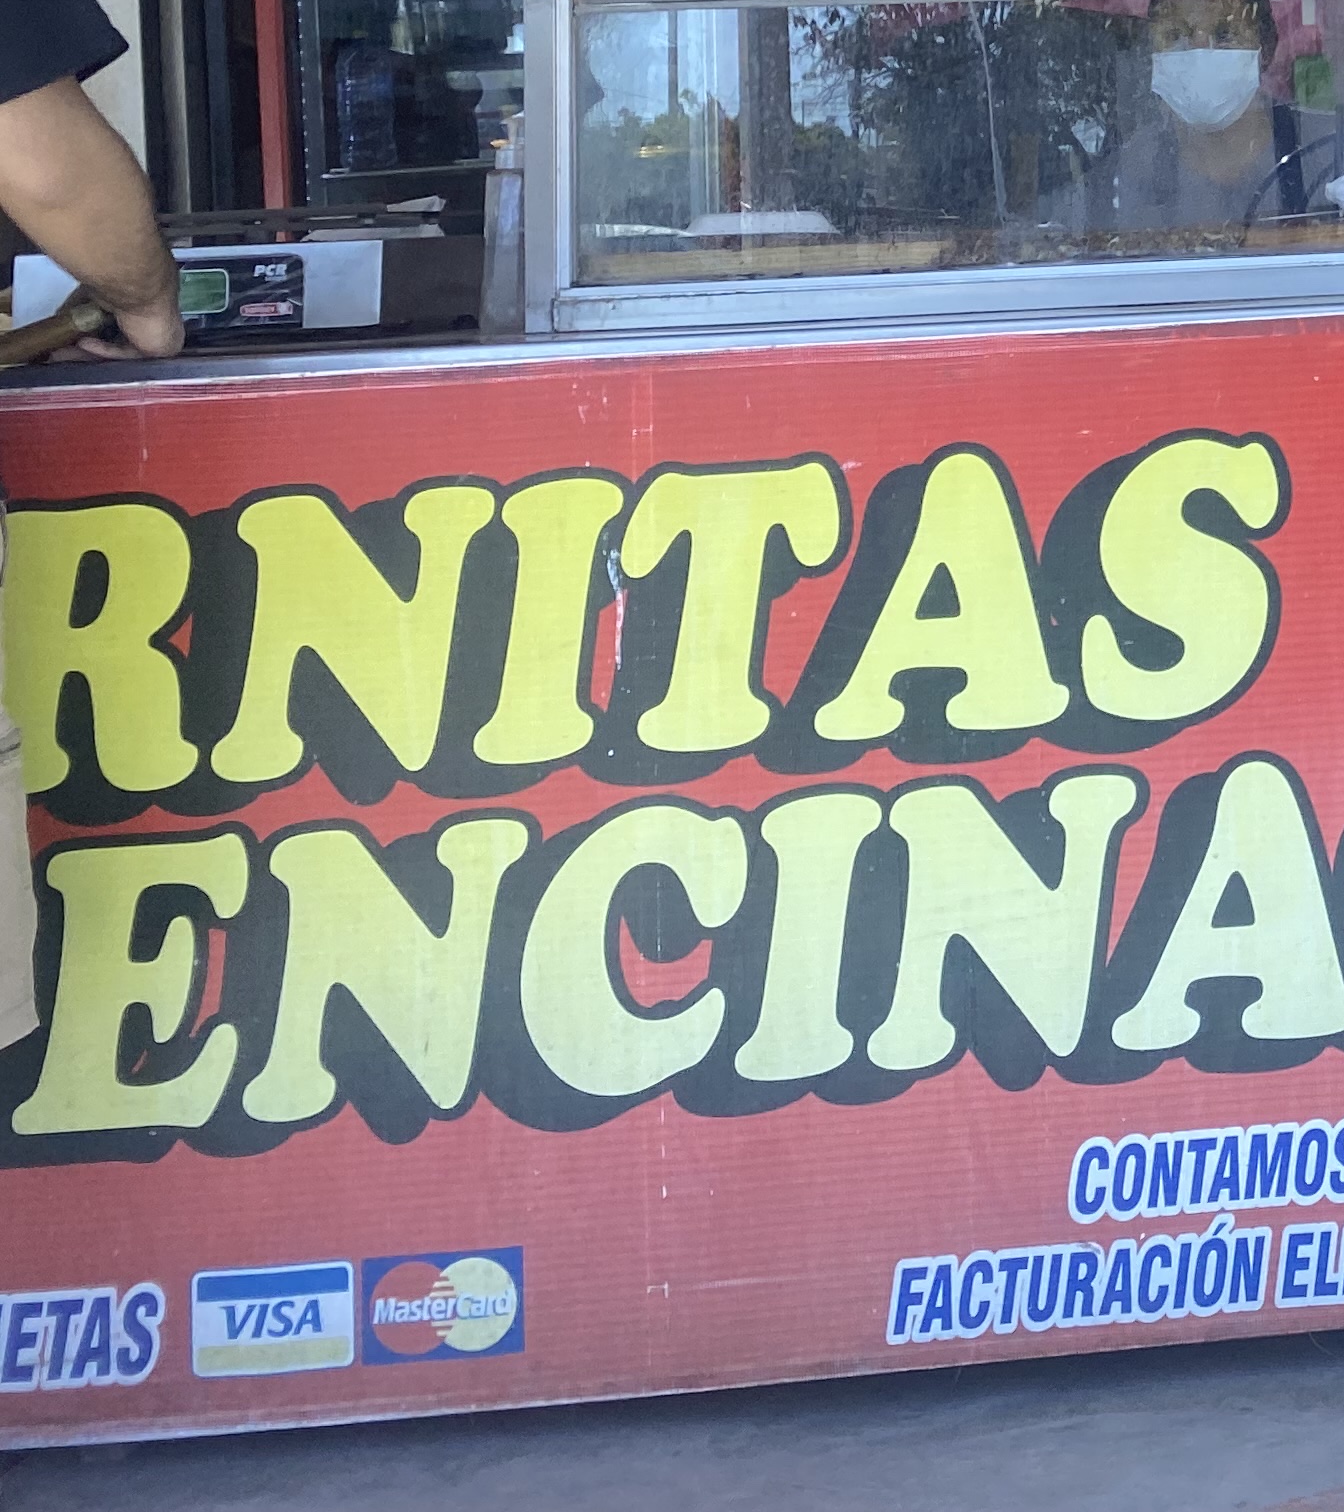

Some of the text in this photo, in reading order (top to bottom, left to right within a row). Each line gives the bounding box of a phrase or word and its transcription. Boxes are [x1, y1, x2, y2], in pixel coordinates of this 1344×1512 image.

[898, 1225, 1266, 1335] FACTURACIÓN
[0, 1287, 516, 1384] ETAS VISA MasterCard
